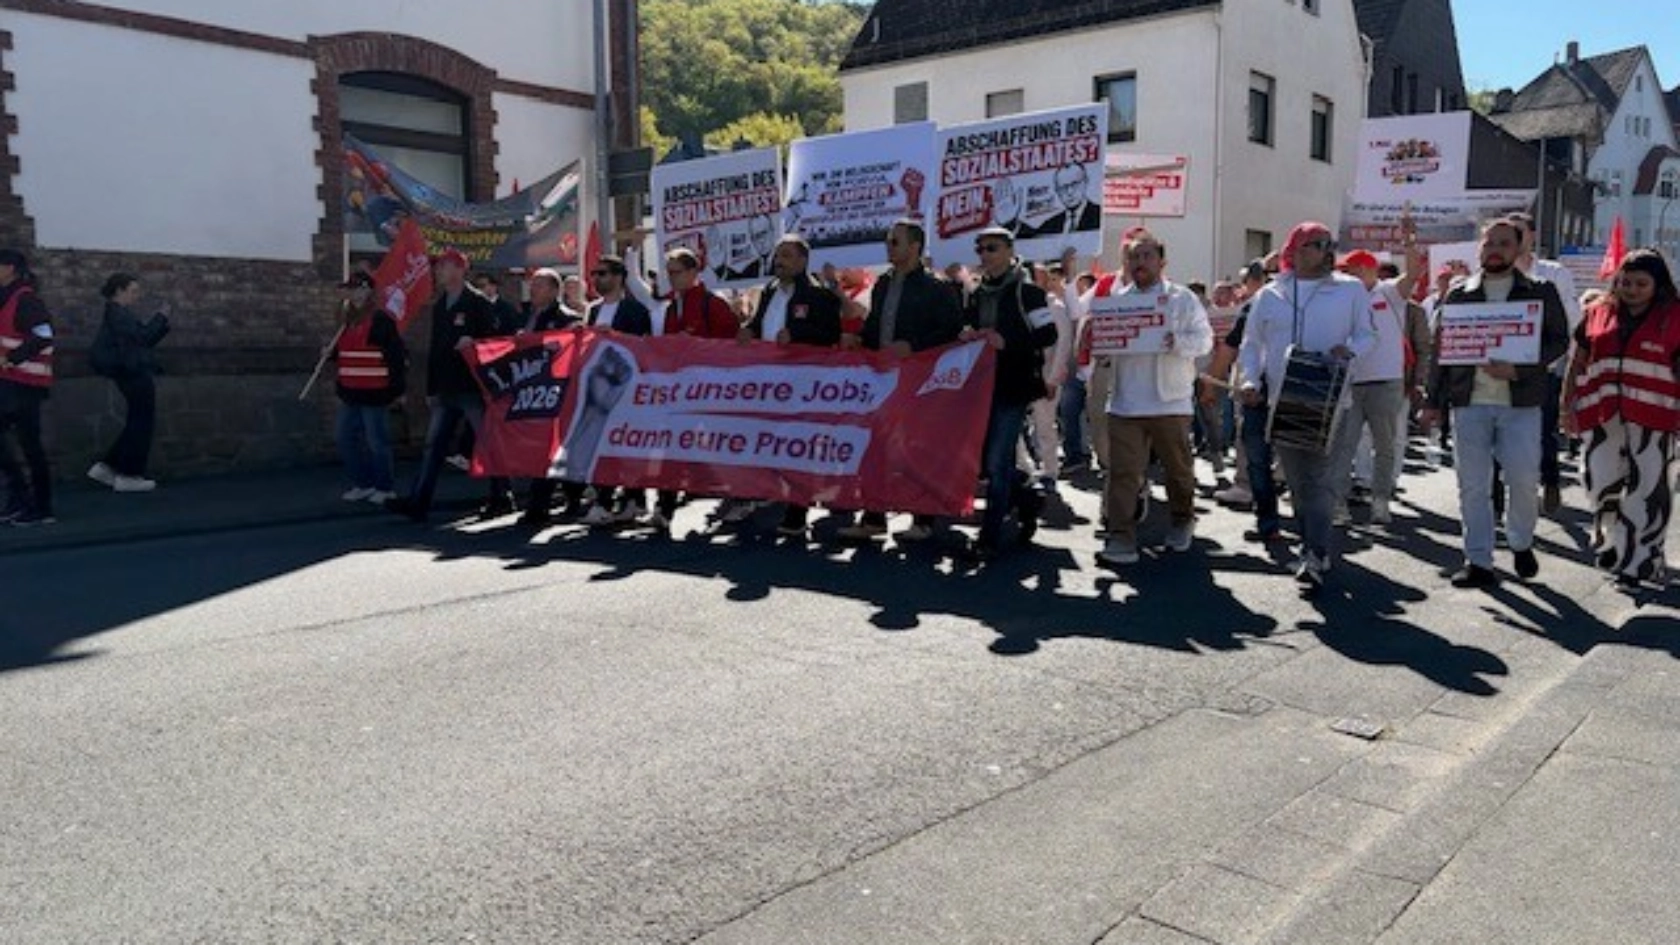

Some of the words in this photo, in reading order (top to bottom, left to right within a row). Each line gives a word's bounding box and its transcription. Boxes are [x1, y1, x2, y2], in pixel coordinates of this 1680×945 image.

[946, 120, 1062, 157] ABSCHAFFUNG
[1066, 114, 1098, 137] DES
[944, 138, 1099, 186] SOZIALSTAATES?
[664, 173, 749, 203] ABSCHAFFUNG
[752, 169, 775, 187] DES
[664, 189, 779, 231] SOZIALSTAATES?
[509, 351, 549, 384] Mai
[511, 385, 561, 412] 2026
[685, 380, 794, 402] unsere
[801, 377, 876, 405] Jobs,
[608, 422, 673, 449] dann
[678, 427, 747, 454] eure
[753, 430, 854, 464] Profite
